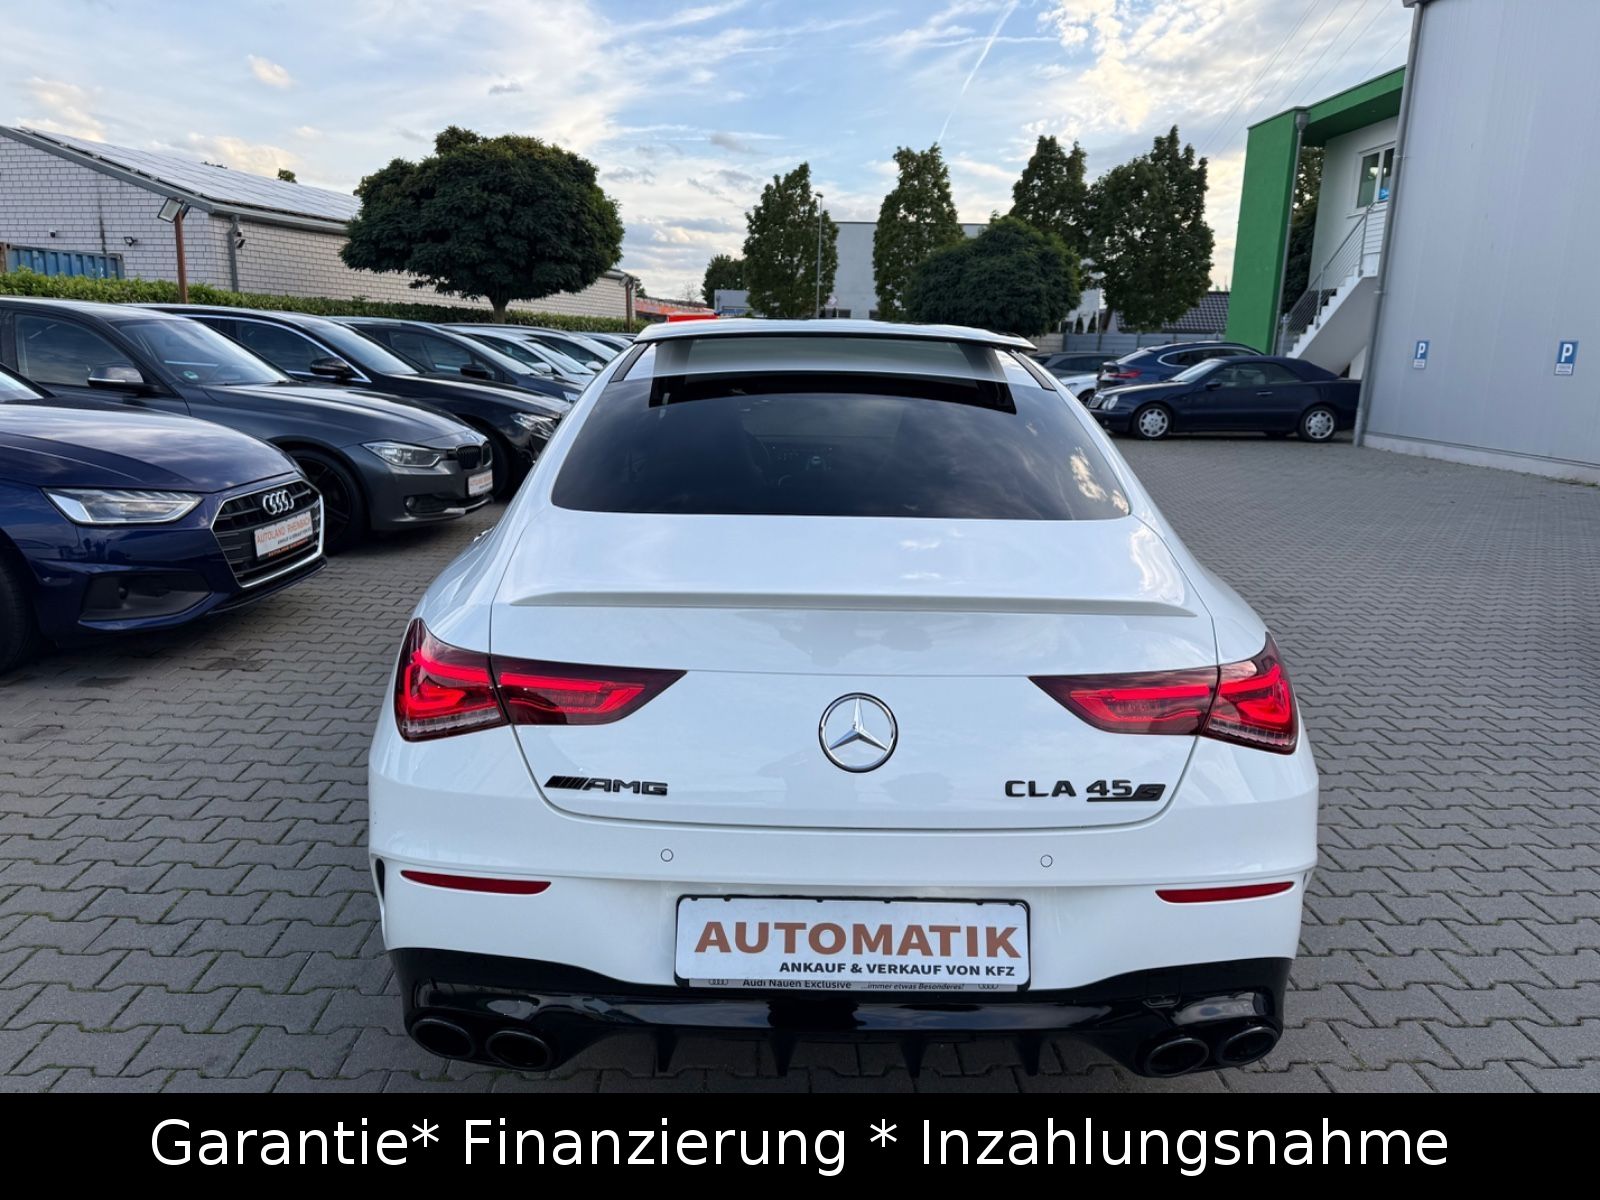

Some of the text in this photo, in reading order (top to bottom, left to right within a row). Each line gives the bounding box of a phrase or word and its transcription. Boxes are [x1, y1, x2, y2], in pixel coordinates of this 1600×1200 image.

[1417, 342, 1426, 359] P
[1561, 343, 1573, 363] P
[582, 776, 669, 797] AMG
[1005, 780, 1077, 798] CLA
[694, 921, 1022, 959] AUTOMATIK
[779, 961, 1016, 977] ANKAUF & VERKAUF VON KFZ
[742, 978, 766, 988] Audi
[769, 979, 801, 988] Nauen
[804, 979, 852, 989] Exclusive
